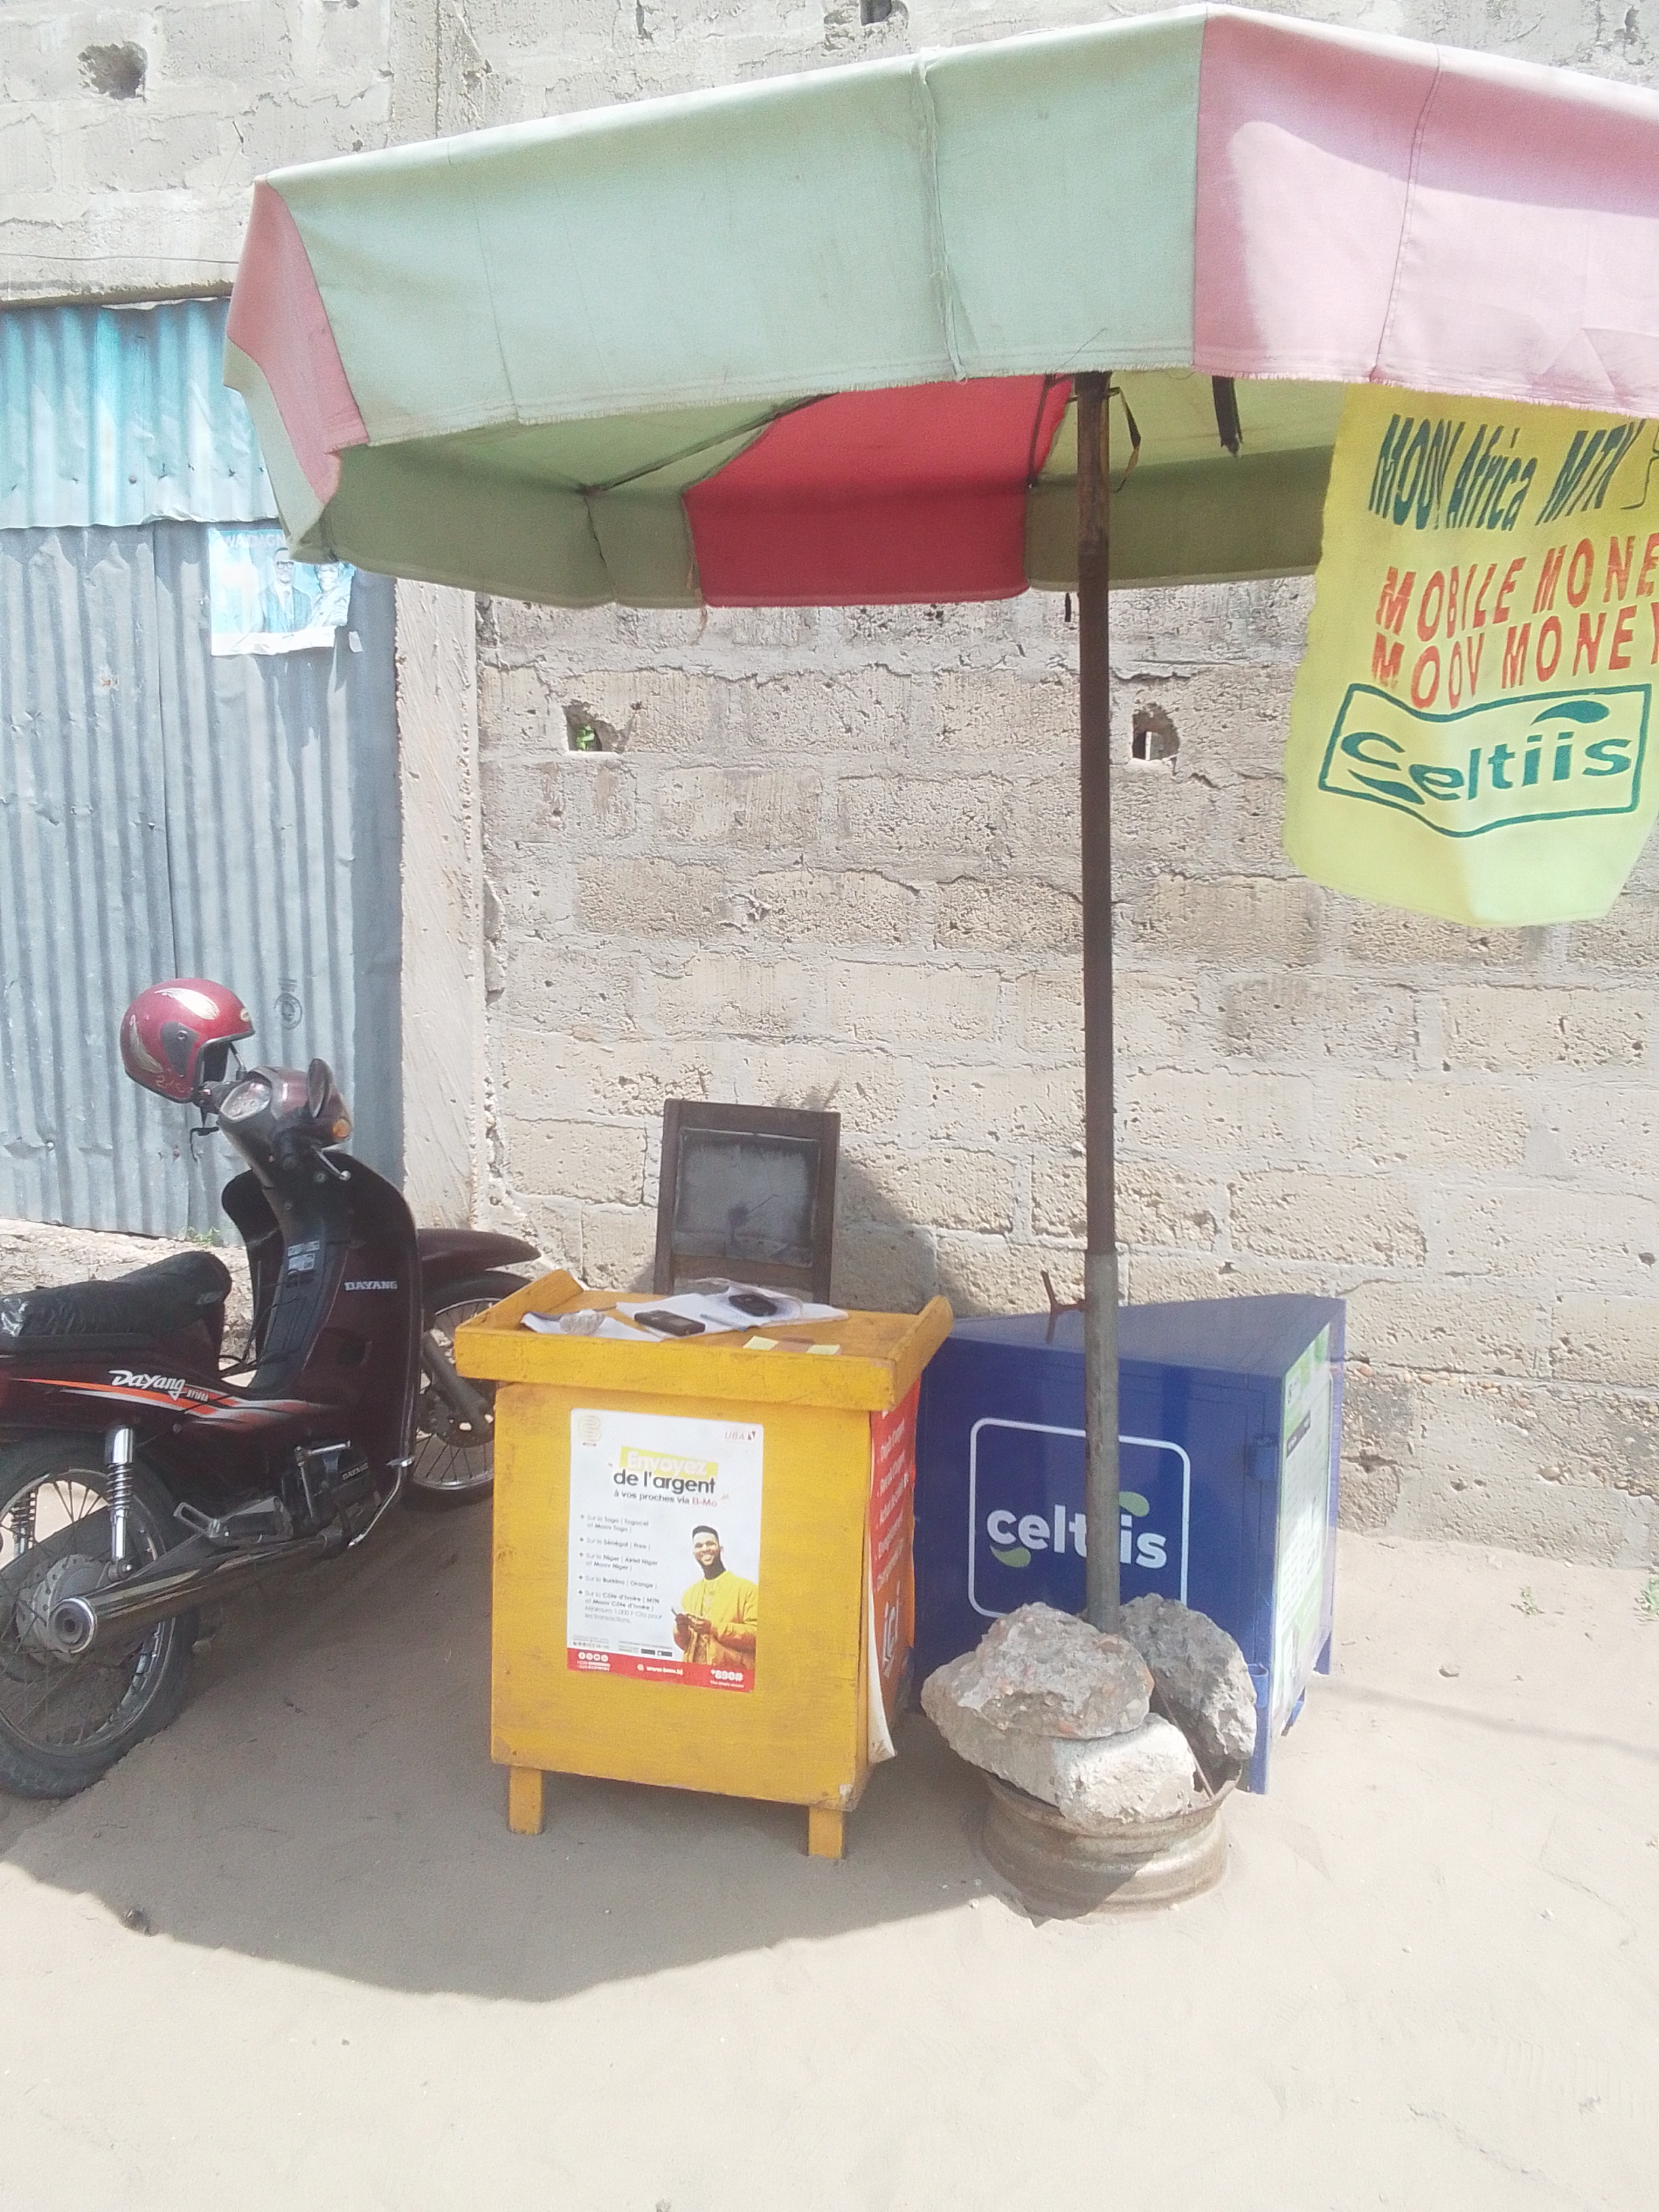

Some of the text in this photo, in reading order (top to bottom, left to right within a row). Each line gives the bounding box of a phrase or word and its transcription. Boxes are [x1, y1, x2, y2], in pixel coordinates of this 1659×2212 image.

[1369, 413, 1647, 531] MOOV Africa MTN
[1376, 557, 1526, 644] MOBILE
[1371, 632, 1486, 710] MOOV
[344, 1280, 398, 1291] DAYANG
[613, 1469, 716, 1494] de l'argent
[626, 1450, 707, 1477] Envoyez
[639, 1493, 674, 1502] proches
[678, 1496, 690, 1504] via
[987, 1504, 1167, 1569] celtis
